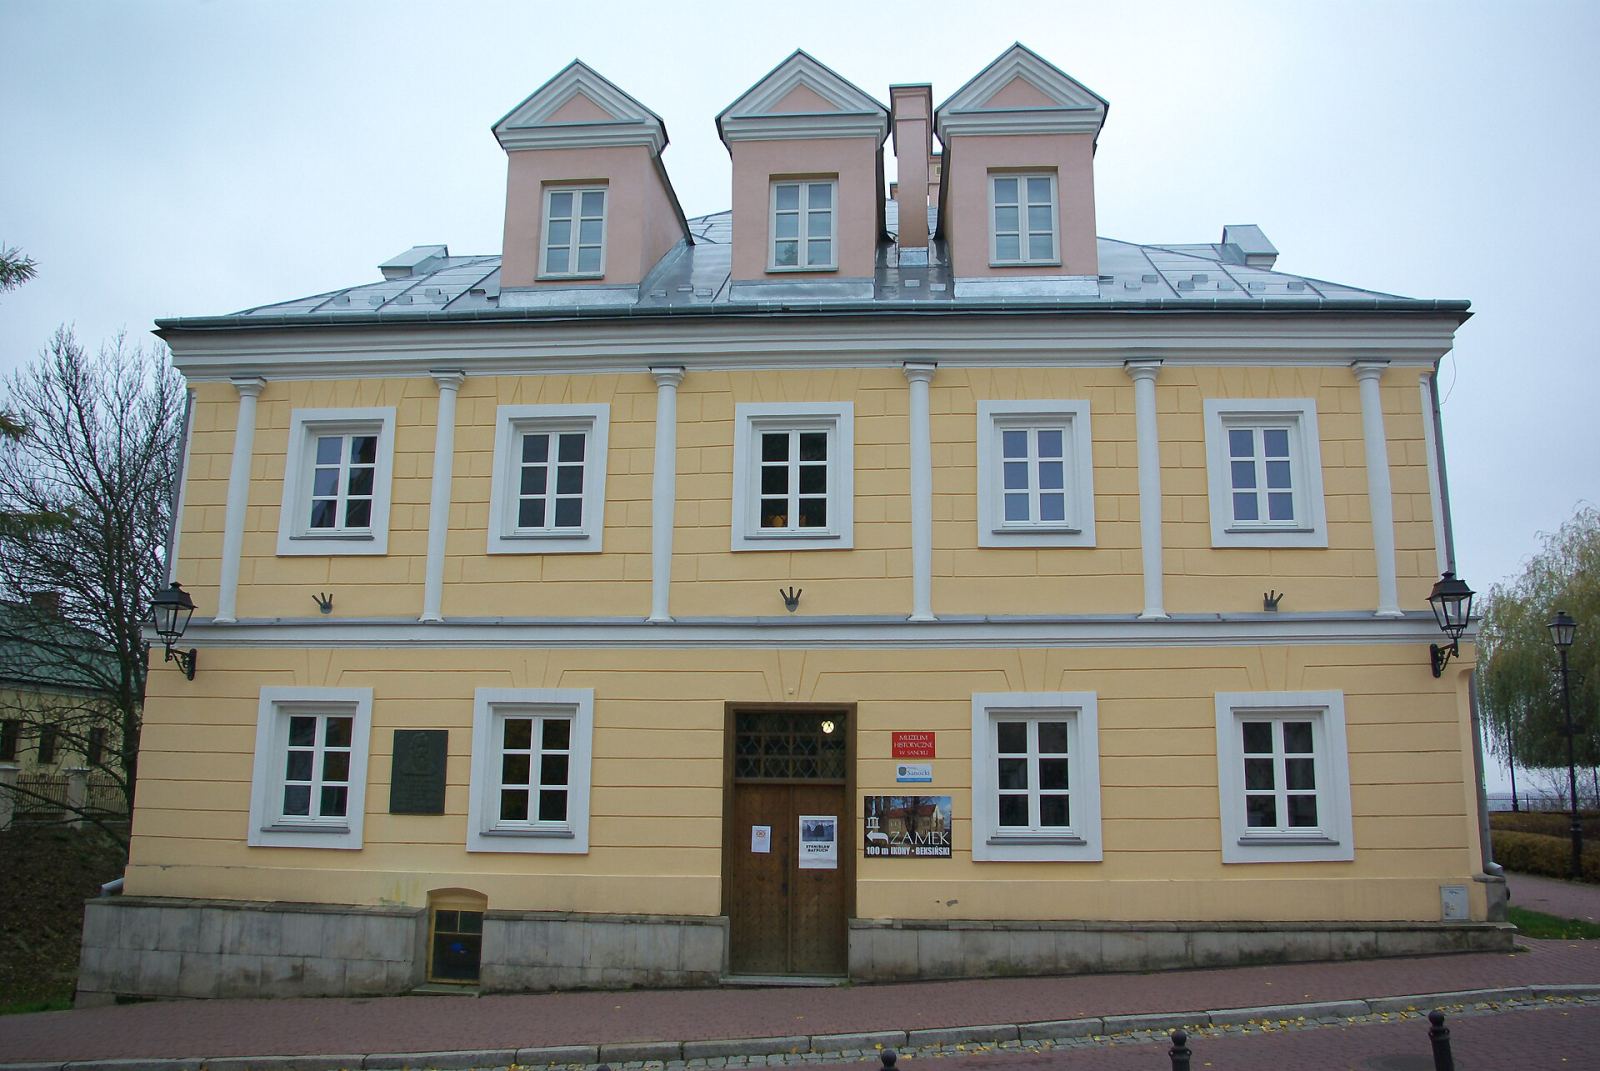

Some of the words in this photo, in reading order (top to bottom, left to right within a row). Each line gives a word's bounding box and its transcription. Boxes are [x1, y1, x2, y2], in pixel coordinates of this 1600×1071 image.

[890, 831, 950, 845] ZAMEK
[866, 846, 880, 855] 100
[881, 846, 889, 855] m
[890, 846, 911, 855] IKONY
[915, 845, 950, 856] BEKSIŃSKI
